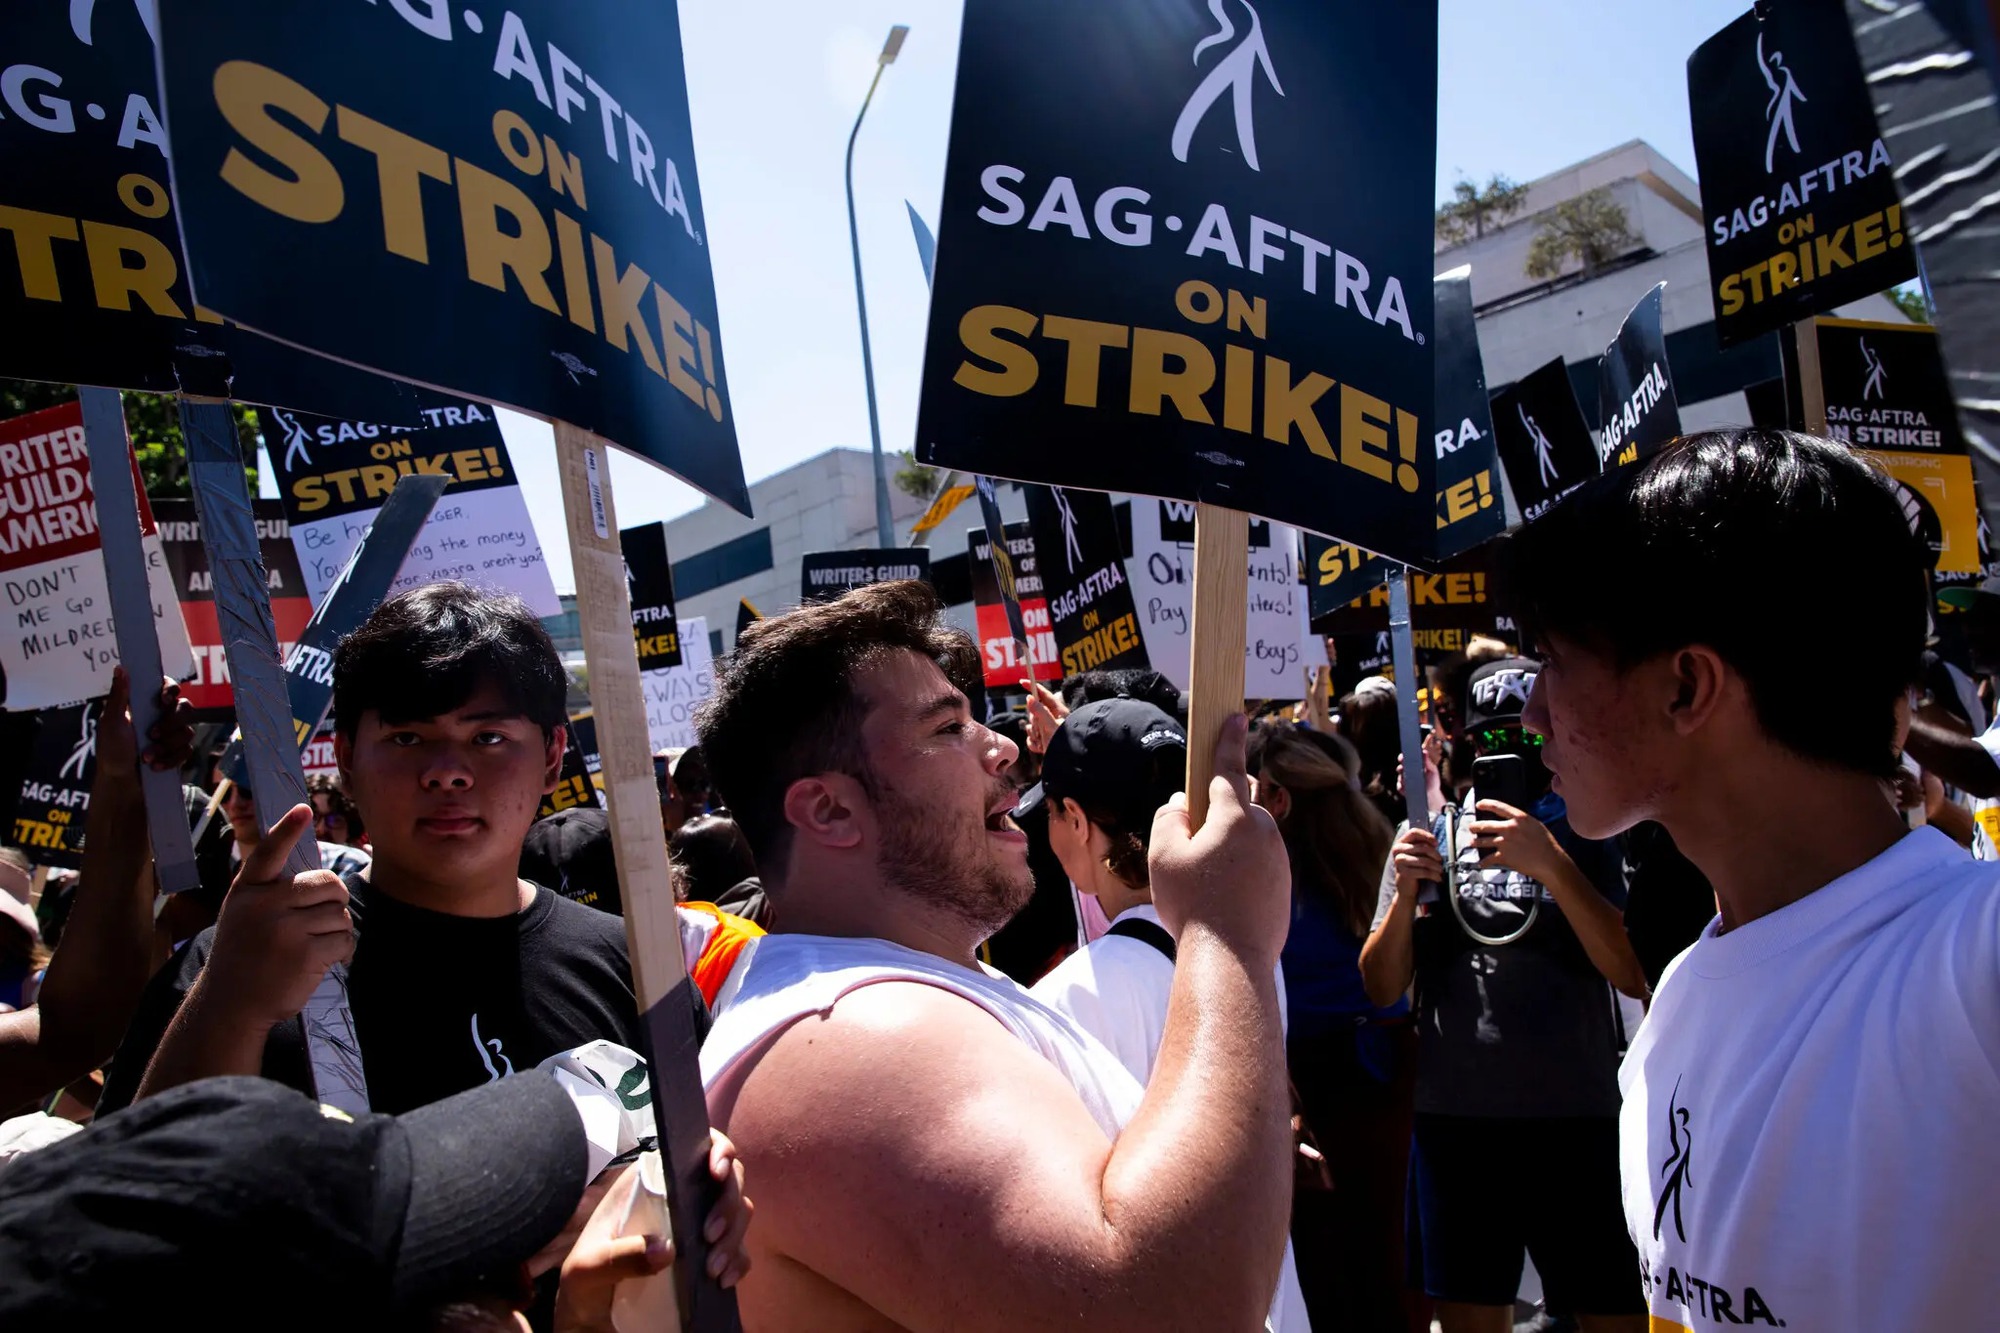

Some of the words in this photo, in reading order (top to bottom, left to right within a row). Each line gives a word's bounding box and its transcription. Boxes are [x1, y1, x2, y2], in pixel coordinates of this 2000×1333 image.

[492, 109, 587, 211] ON
[117, 173, 170, 218] O
[1713, 137, 1891, 246] SAG·AFTRA
[213, 59, 723, 421] STRIKE!
[1778, 213, 1815, 245] ON
[1719, 203, 1904, 317] STRIKE!
[1175, 280, 1267, 340] ON
[952, 305, 1420, 493] STRIKE!
[1827, 405, 1931, 427] SAG·AFTRA
[370, 439, 413, 460] ON
[1855, 426, 1941, 447] STRIKE!
[304, 528, 335, 550] Be
[441, 537, 469, 552] the
[478, 531, 526, 547] money
[810, 567, 874, 586] WRITERS
[877, 564, 921, 581] GUILD
[1021, 558, 1036, 572] OF
[6, 565, 79, 605] DON'T
[1052, 561, 1124, 623] SAG·AFTRA
[18, 609, 50, 628] ME
[1023, 606, 1049, 628] ON
[1082, 610, 1099, 630] ON
[1149, 597, 1188, 636] Pay
[1062, 612, 1140, 678] STRIKE!
[46, 808, 72, 824] ON
